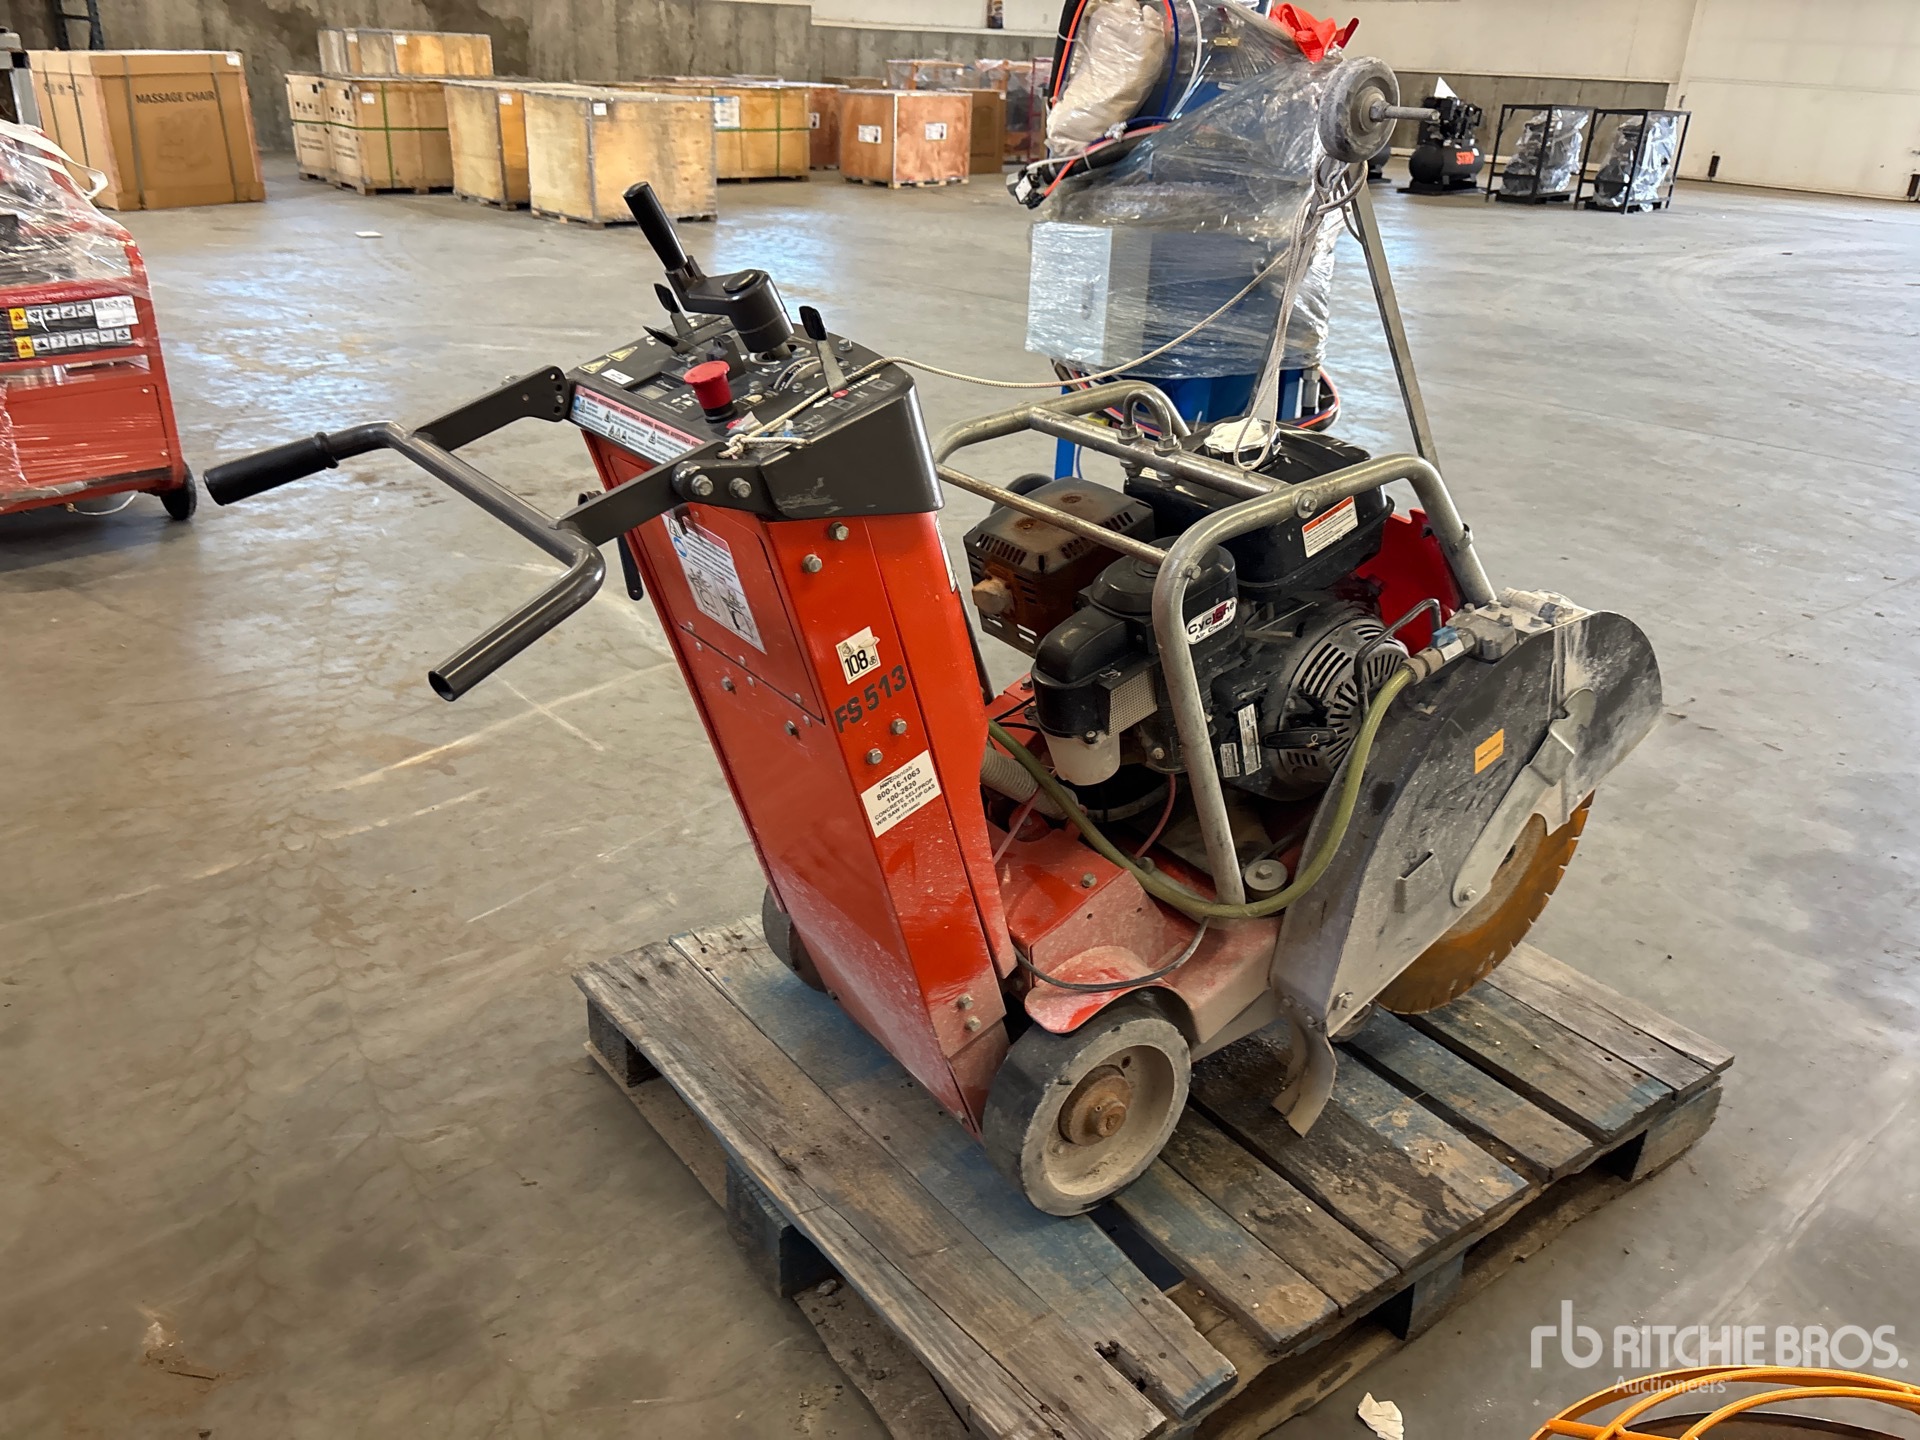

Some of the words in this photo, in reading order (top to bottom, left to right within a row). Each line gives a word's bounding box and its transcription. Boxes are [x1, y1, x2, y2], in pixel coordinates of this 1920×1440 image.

[135, 91, 184, 104] MASSAGE
[186, 90, 216, 102] CHAIR
[1188, 601, 1235, 636] Cyclone
[844, 649, 869, 677] 108
[834, 696, 863, 734] FS
[863, 664, 907, 711] 513
[876, 767, 921, 801] 800-16-1063
[886, 780, 917, 804] 100-2820
[874, 797, 904, 820] CONCRETE
[887, 807, 900, 818] SAW
[923, 783, 936, 794] GAS
